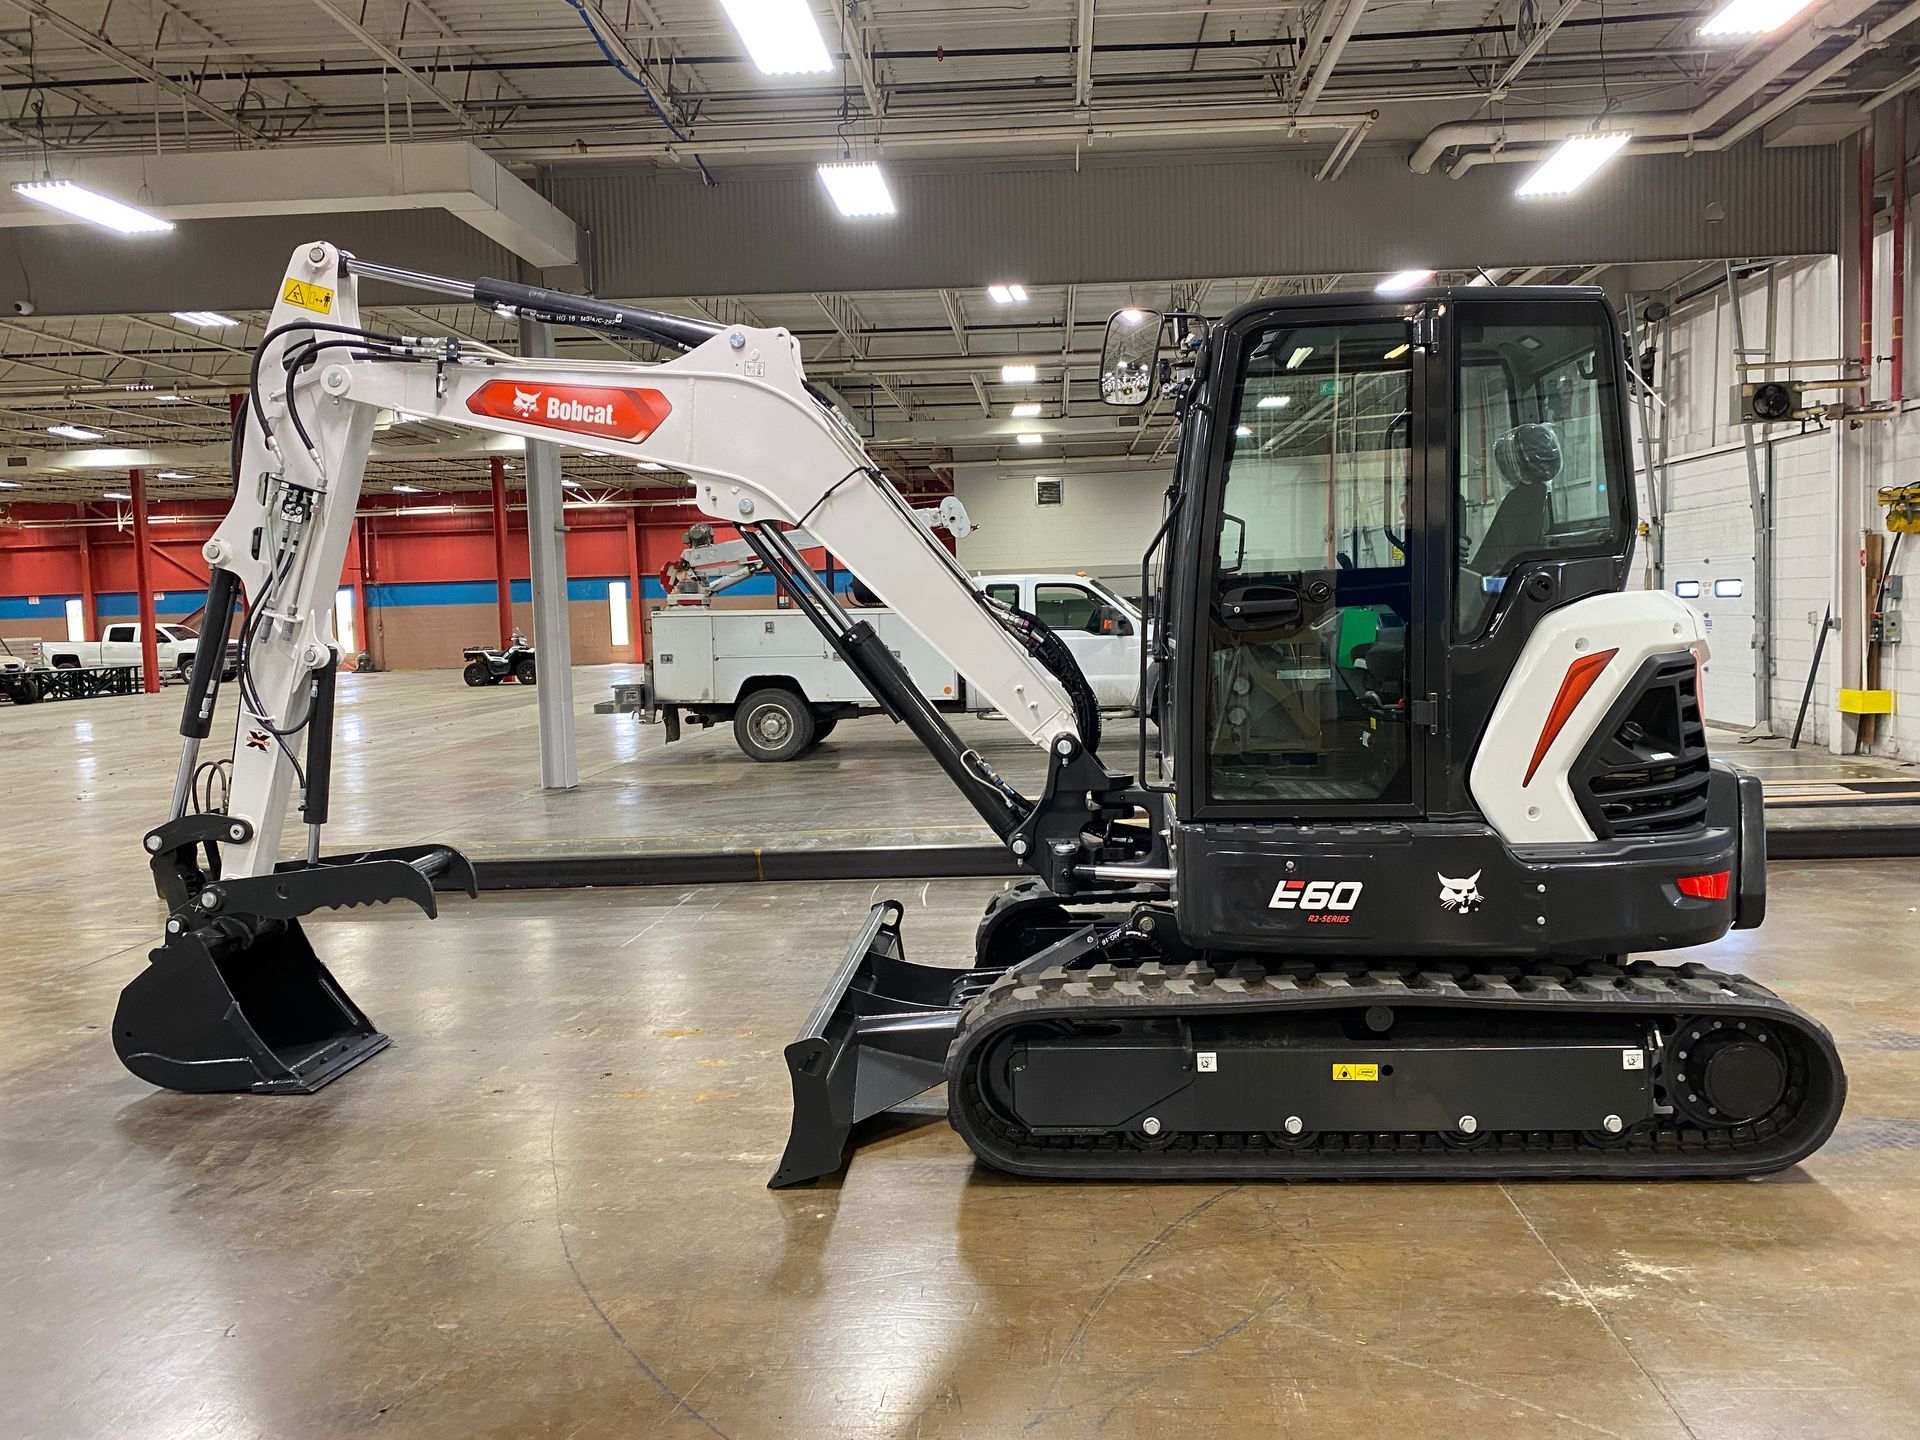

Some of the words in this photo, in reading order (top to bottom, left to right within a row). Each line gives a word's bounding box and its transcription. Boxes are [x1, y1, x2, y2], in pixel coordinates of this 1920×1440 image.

[546, 397, 614, 425] Bobcat
[1268, 880, 1363, 910] E60
[1307, 914, 1350, 923] R2-SERIES
